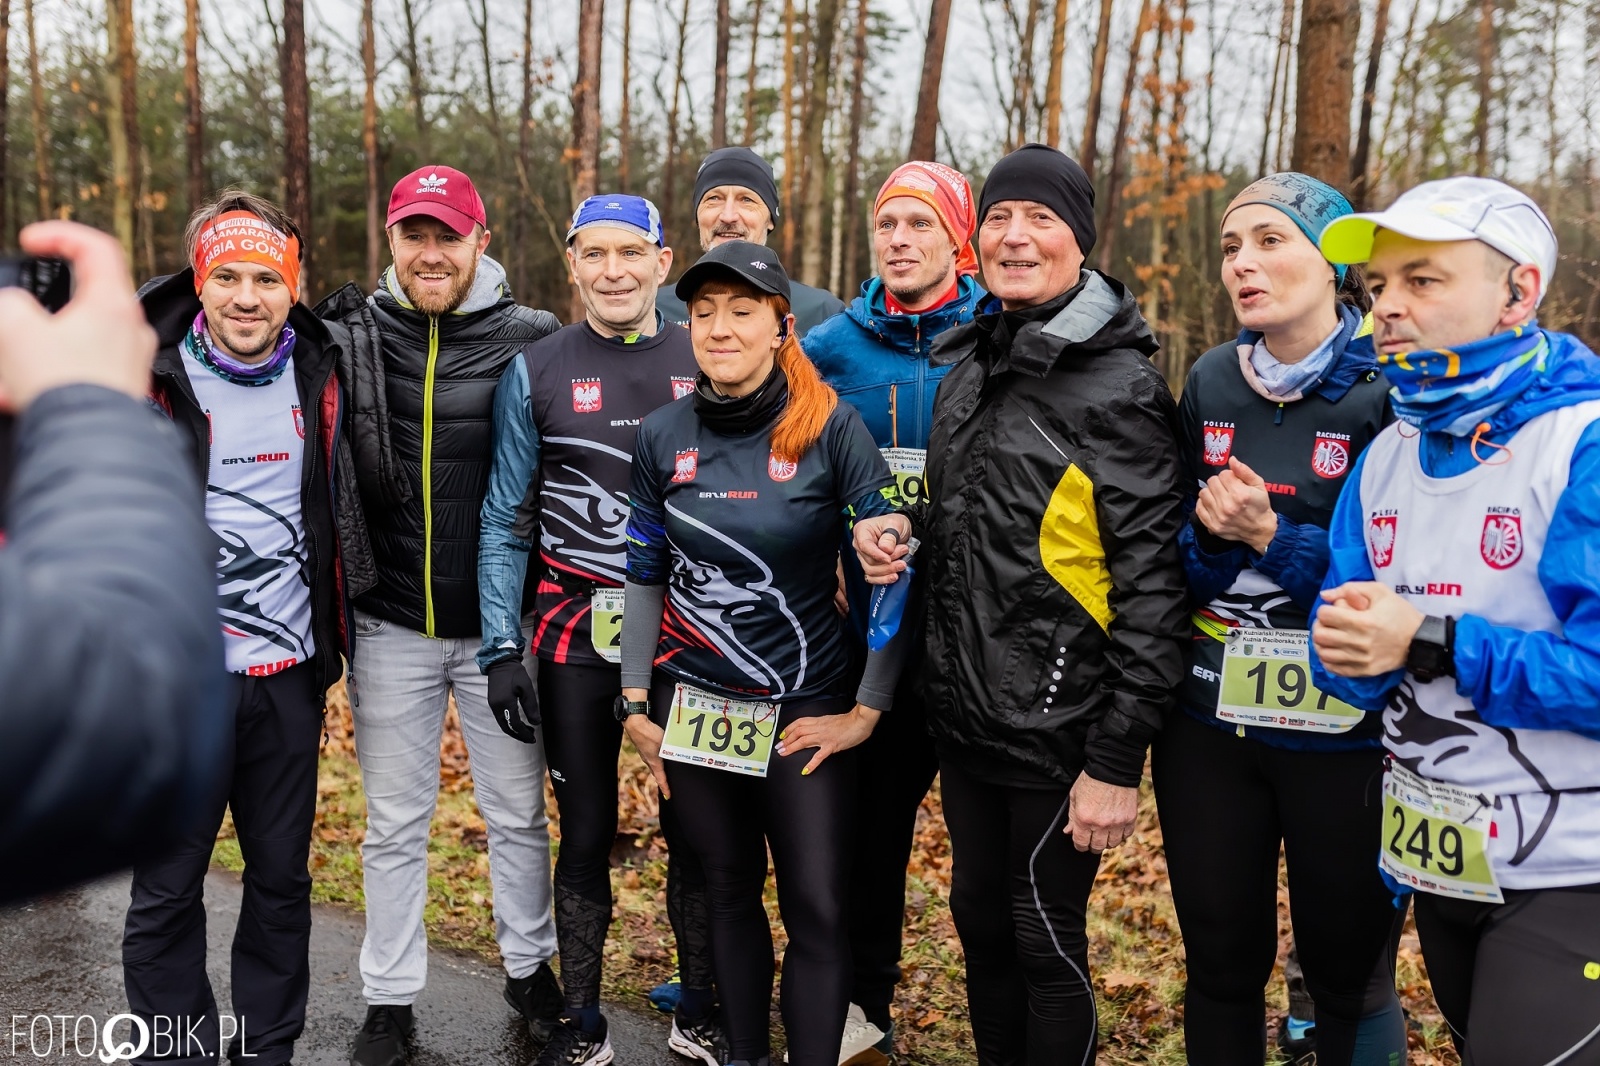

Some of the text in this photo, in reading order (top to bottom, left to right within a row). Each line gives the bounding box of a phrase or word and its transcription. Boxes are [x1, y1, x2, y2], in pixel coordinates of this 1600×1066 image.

[416, 187, 447, 195] adidas
[205, 239, 283, 267] BABIA GÓRA
[750, 261, 768, 270] 4F
[1203, 420, 1235, 429] POLSKA
[1315, 431, 1351, 441] RACIBÓRZ
[687, 713, 757, 757] 193
[1390, 805, 1464, 876] 249
